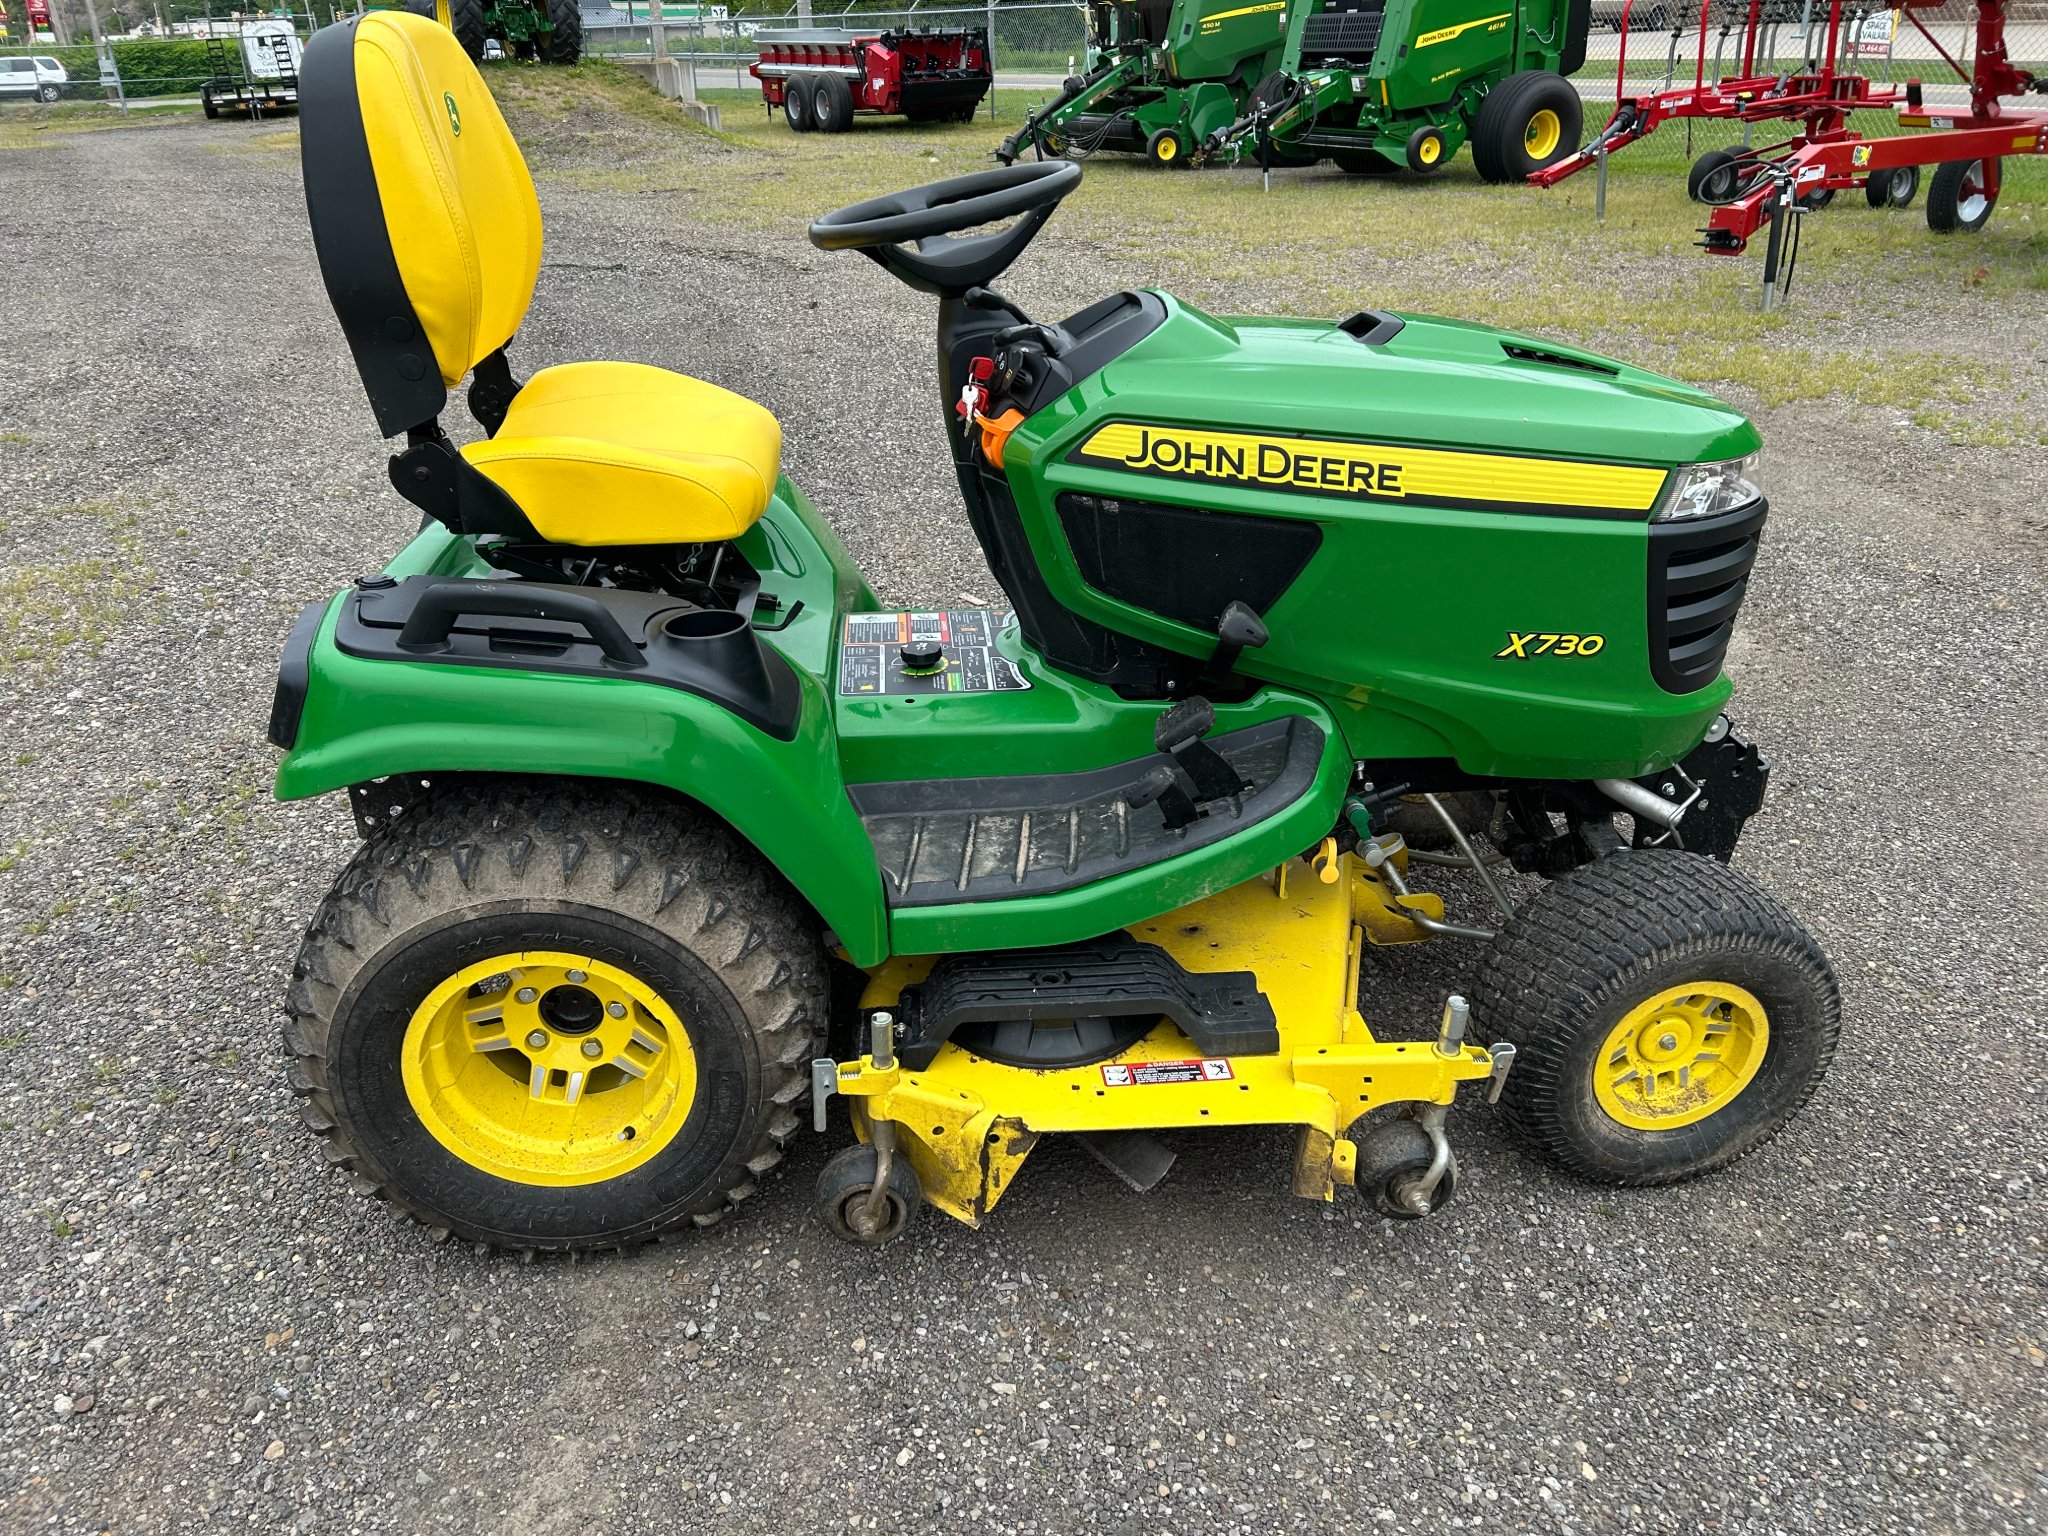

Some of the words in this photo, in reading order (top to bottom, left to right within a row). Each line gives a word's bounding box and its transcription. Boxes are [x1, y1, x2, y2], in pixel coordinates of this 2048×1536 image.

[1866, 21, 1886, 30] SPACE
[1421, 34, 1436, 43] JOHN
[1437, 30, 1456, 39] DEERE
[1126, 430, 1245, 476] JOHN
[1257, 444, 1405, 494] DEERE
[1496, 632, 1605, 659] X730
